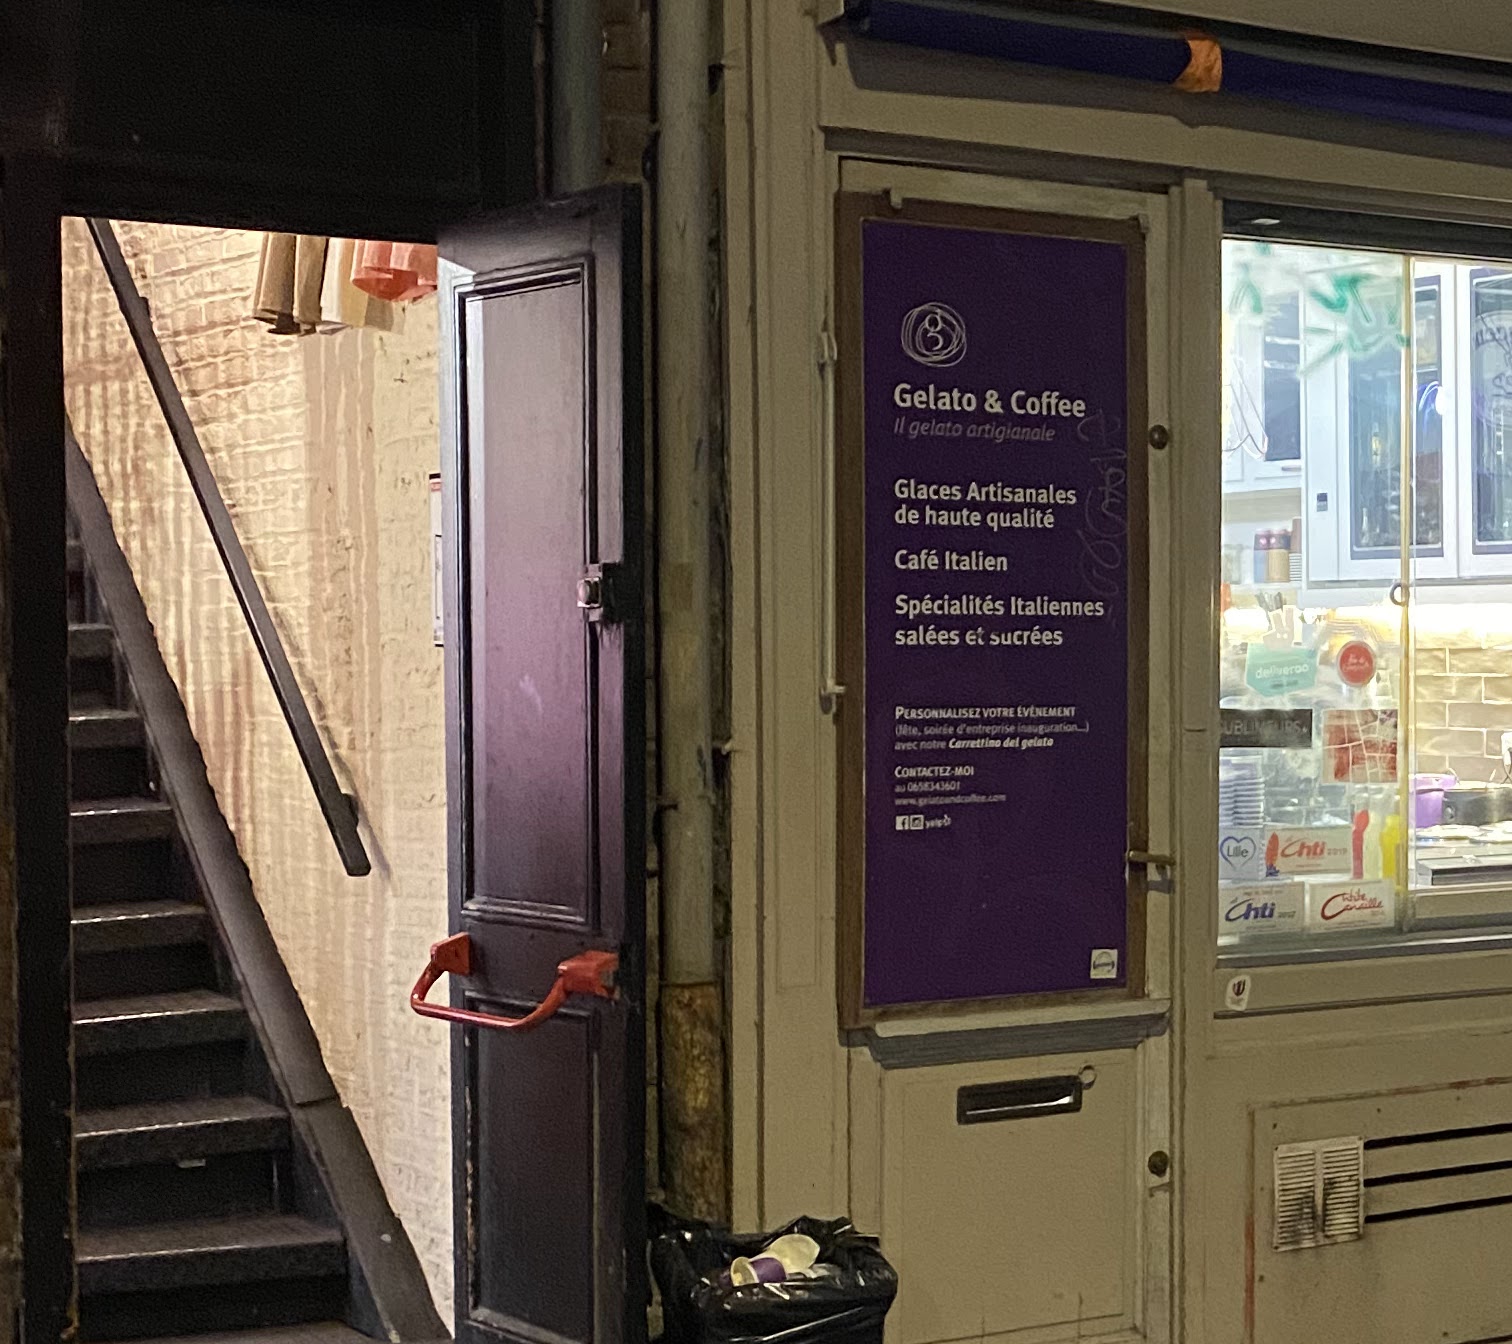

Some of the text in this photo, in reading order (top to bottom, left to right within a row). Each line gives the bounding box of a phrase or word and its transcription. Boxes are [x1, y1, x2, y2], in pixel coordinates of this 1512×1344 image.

[894, 383, 1087, 418] Gelato & Coffee
[894, 416, 1056, 443] Il gelato artigianale
[894, 479, 1078, 506] Glaces Artisanales
[894, 505, 1055, 531] de haute qualité
[894, 549, 1008, 572] Café Italien
[895, 594, 1105, 618] Spécialités Italiennes
[895, 625, 1064, 646] salées et sucrées
[1256, 663, 1309, 679] deliveroo
[982, 707, 1015, 718] VOTRE
[924, 723, 954, 735] soirée
[895, 740, 918, 751] avec
[920, 739, 947, 750] notre
[1003, 736, 1020, 748] del
[1021, 736, 1054, 750] gelato
[1227, 844, 1250, 858] Lille
